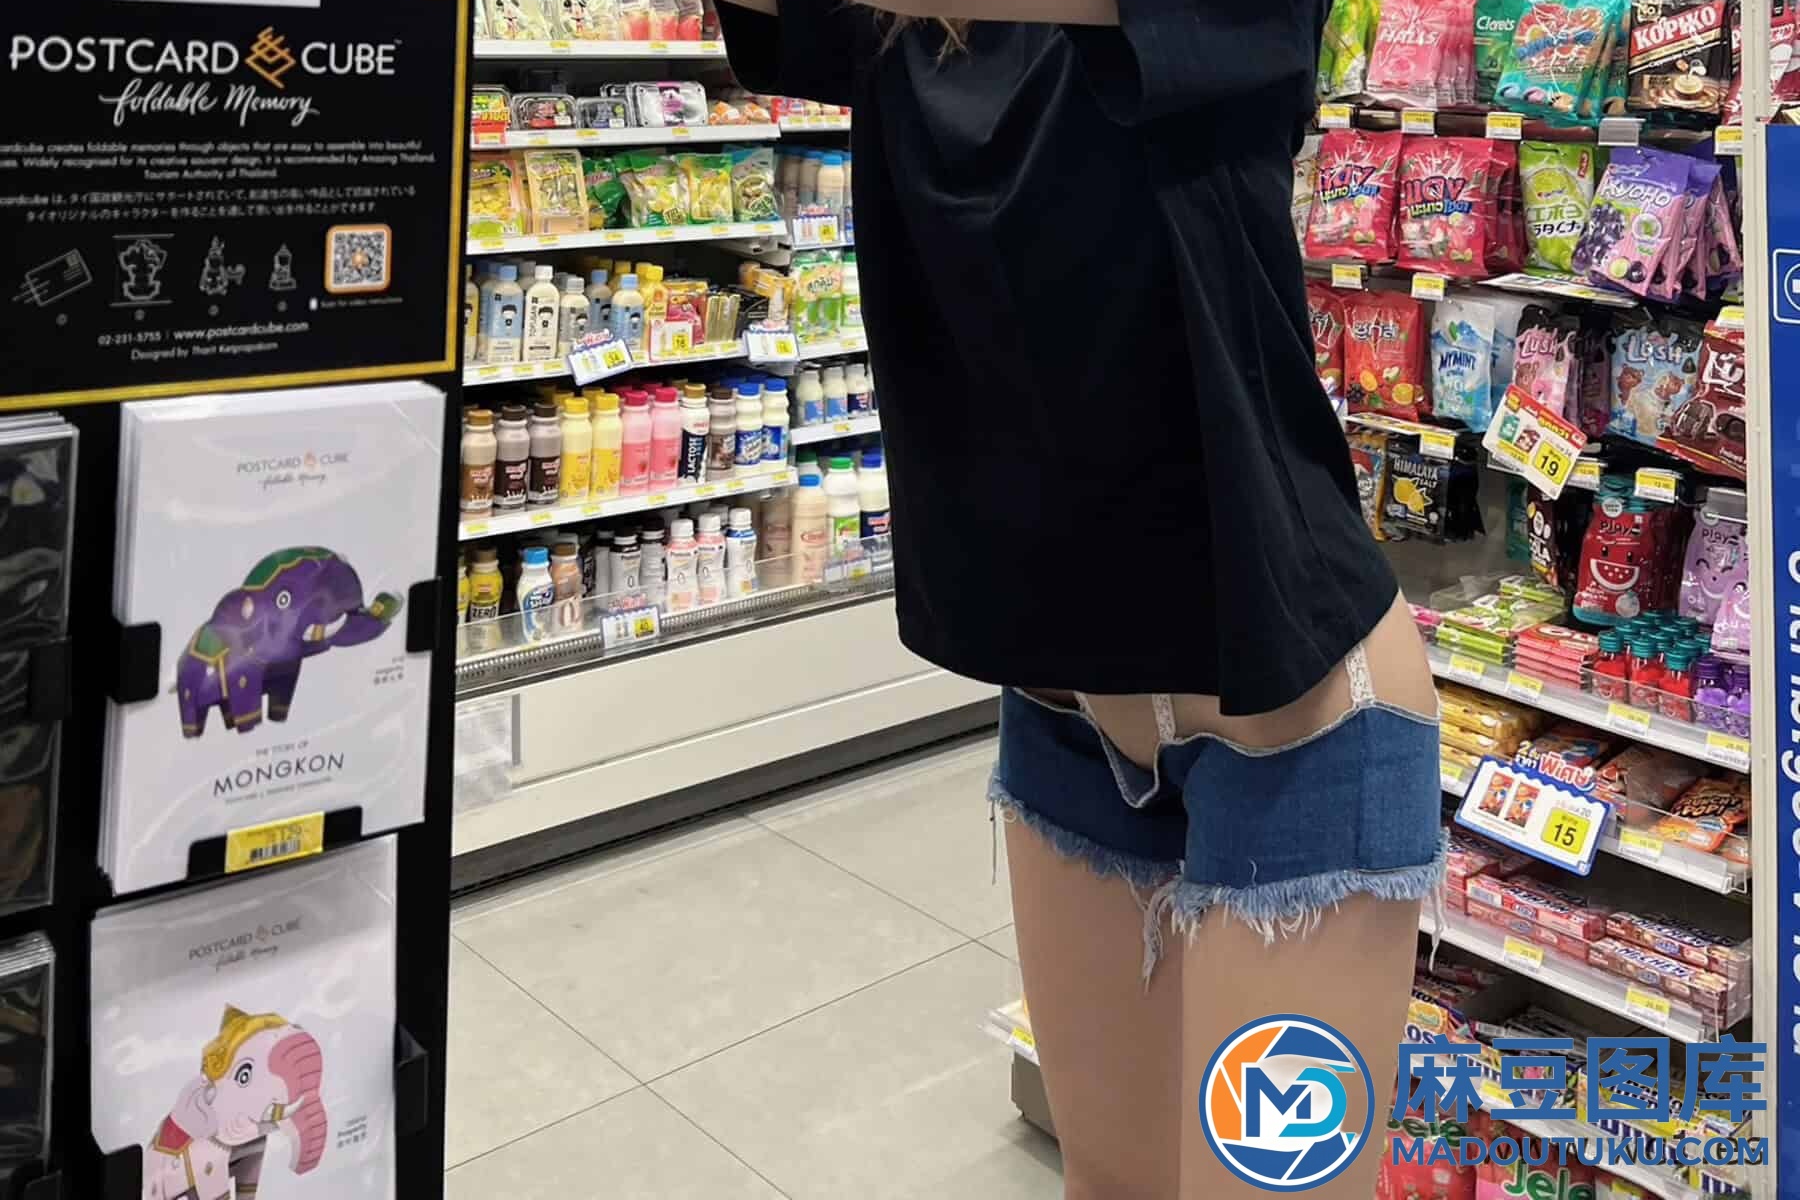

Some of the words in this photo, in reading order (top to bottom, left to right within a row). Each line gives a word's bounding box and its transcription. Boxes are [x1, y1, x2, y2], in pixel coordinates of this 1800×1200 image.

[1633, 5, 1717, 52] KOPIKO
[9, 35, 239, 74] POSTCARD
[301, 42, 396, 75] CUBE
[99, 78, 218, 126] foldable
[223, 84, 320, 126] Memory
[1626, 334, 1684, 365] LUSH
[236, 456, 302, 473] POSTCARD
[1540, 455, 1560, 477] 19
[471, 604, 497, 619] ZERO
[213, 752, 345, 798] MONGKON
[1554, 822, 1577, 847] 15
[188, 933, 253, 961] POSTCARD
